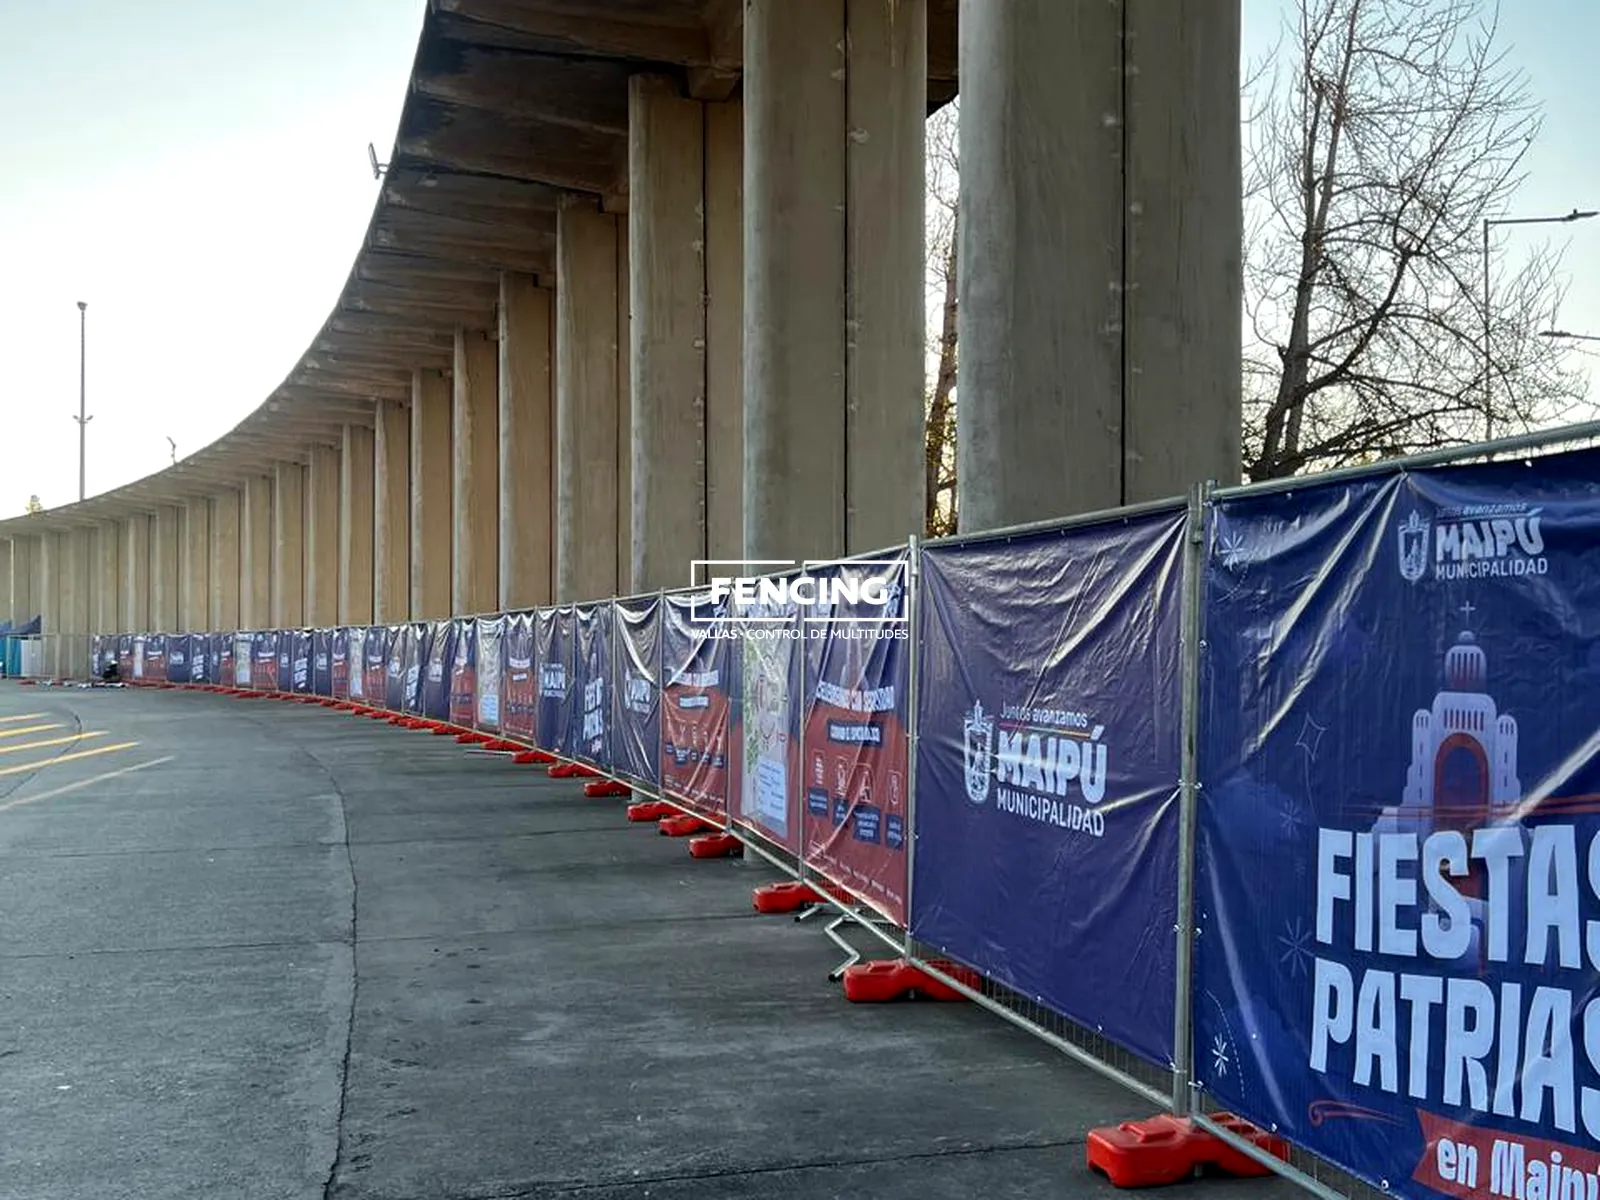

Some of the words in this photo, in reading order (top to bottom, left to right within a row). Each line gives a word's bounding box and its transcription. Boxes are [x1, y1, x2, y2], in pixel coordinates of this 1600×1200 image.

[1435, 557, 1549, 581] MUNICIPALIDAD
[998, 725, 1107, 804] MAIPÚ
[997, 787, 1105, 837] MUNICIPALIDAD
[1315, 825, 1600, 975] FIESTA
[1437, 1137, 1478, 1189] en
